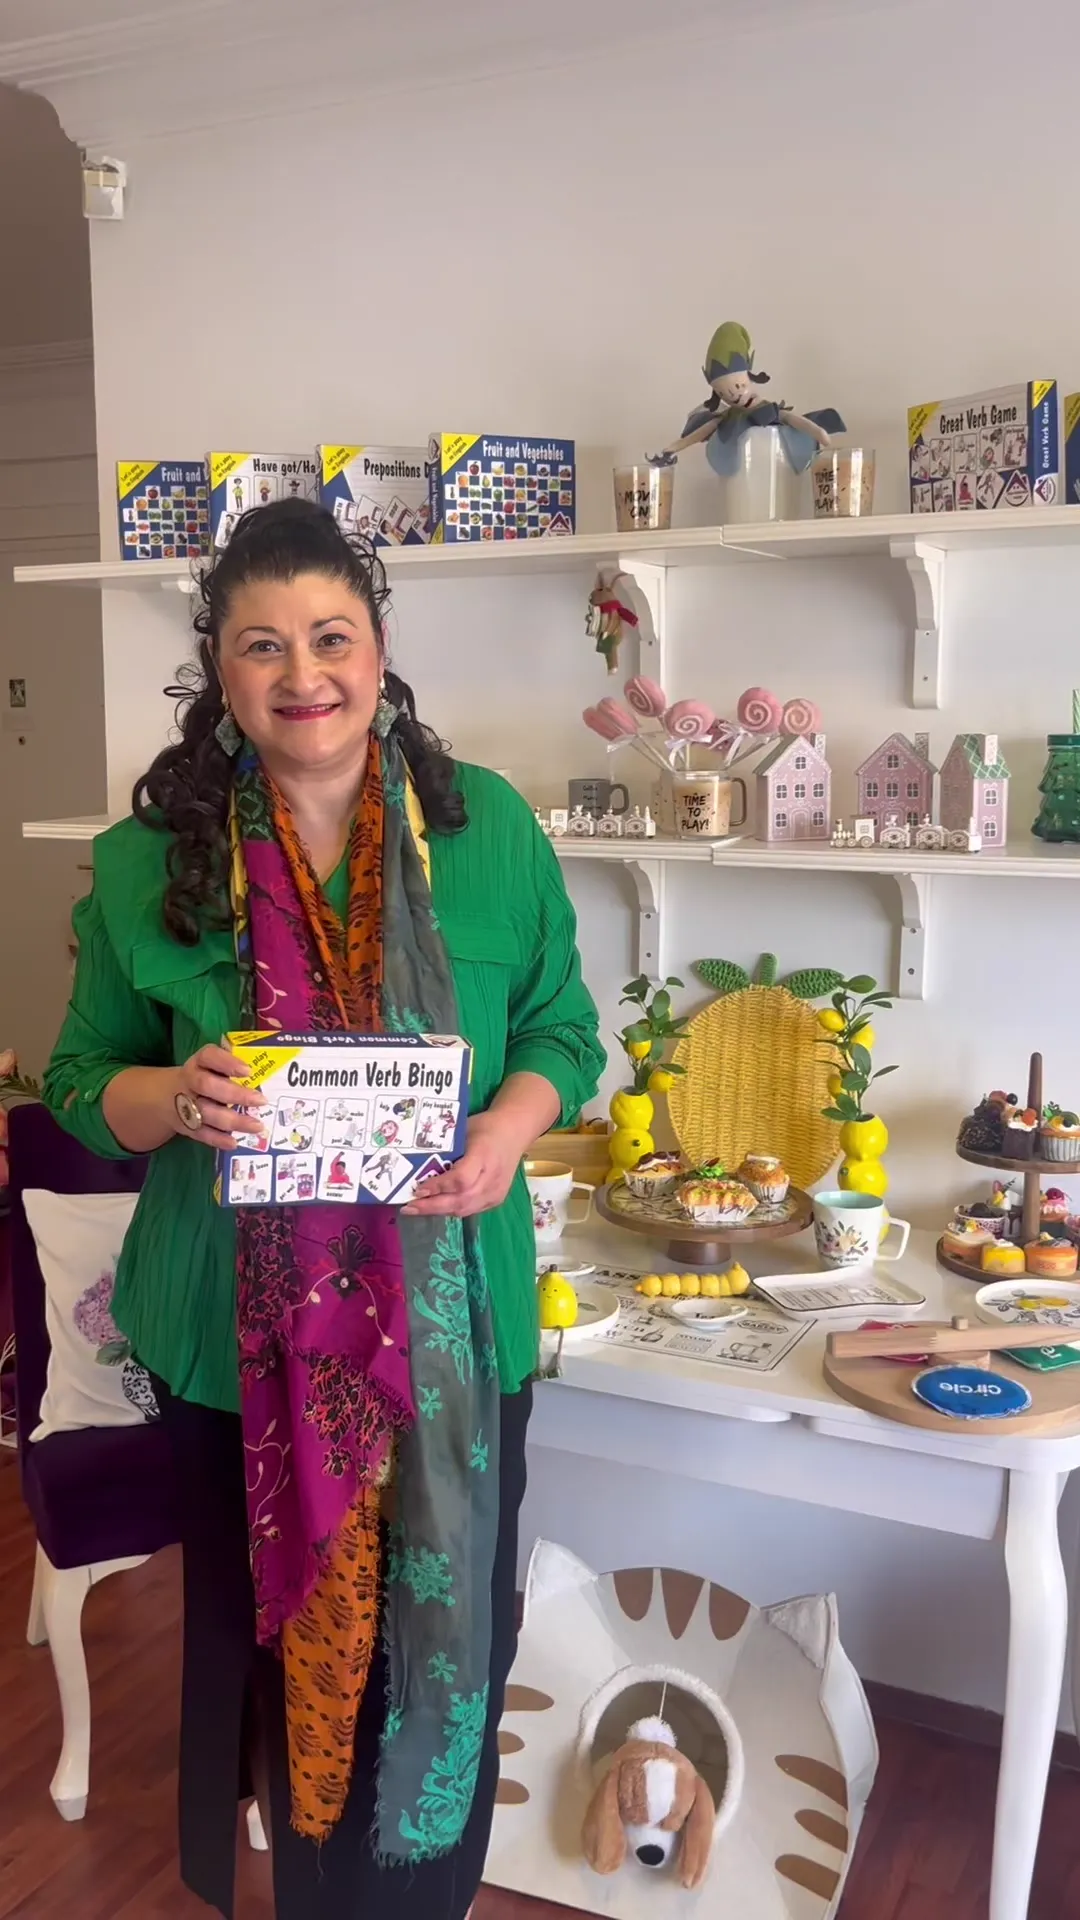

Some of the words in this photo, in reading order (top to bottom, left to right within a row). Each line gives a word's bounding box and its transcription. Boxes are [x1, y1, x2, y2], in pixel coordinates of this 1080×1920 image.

[940, 414, 964, 435] Great
[966, 405, 987, 430] Verb
[990, 404, 1017, 424] Game
[482, 440, 503, 458] Fruit
[505, 442, 520, 459] and
[521, 442, 564, 464] Vegetables
[252, 458, 278, 473] Have
[363, 458, 421, 482] Prepositions
[161, 466, 183, 482] Fruit
[185, 466, 201, 482] and
[814, 470, 834, 484] TIME
[818, 484, 830, 497] TO
[683, 792, 707, 806] TIME
[688, 807, 701, 818] TO
[681, 818, 709, 833] PLAY!
[277, 1032, 318, 1043] Bingo
[323, 1033, 354, 1044] Verb
[358, 1034, 418, 1045] Common
[252, 1051, 269, 1067] play
[287, 1061, 358, 1088] Common
[366, 1061, 401, 1087] Verb
[408, 1062, 453, 1095] Bingo
[939, 1382, 1002, 1397] circle
